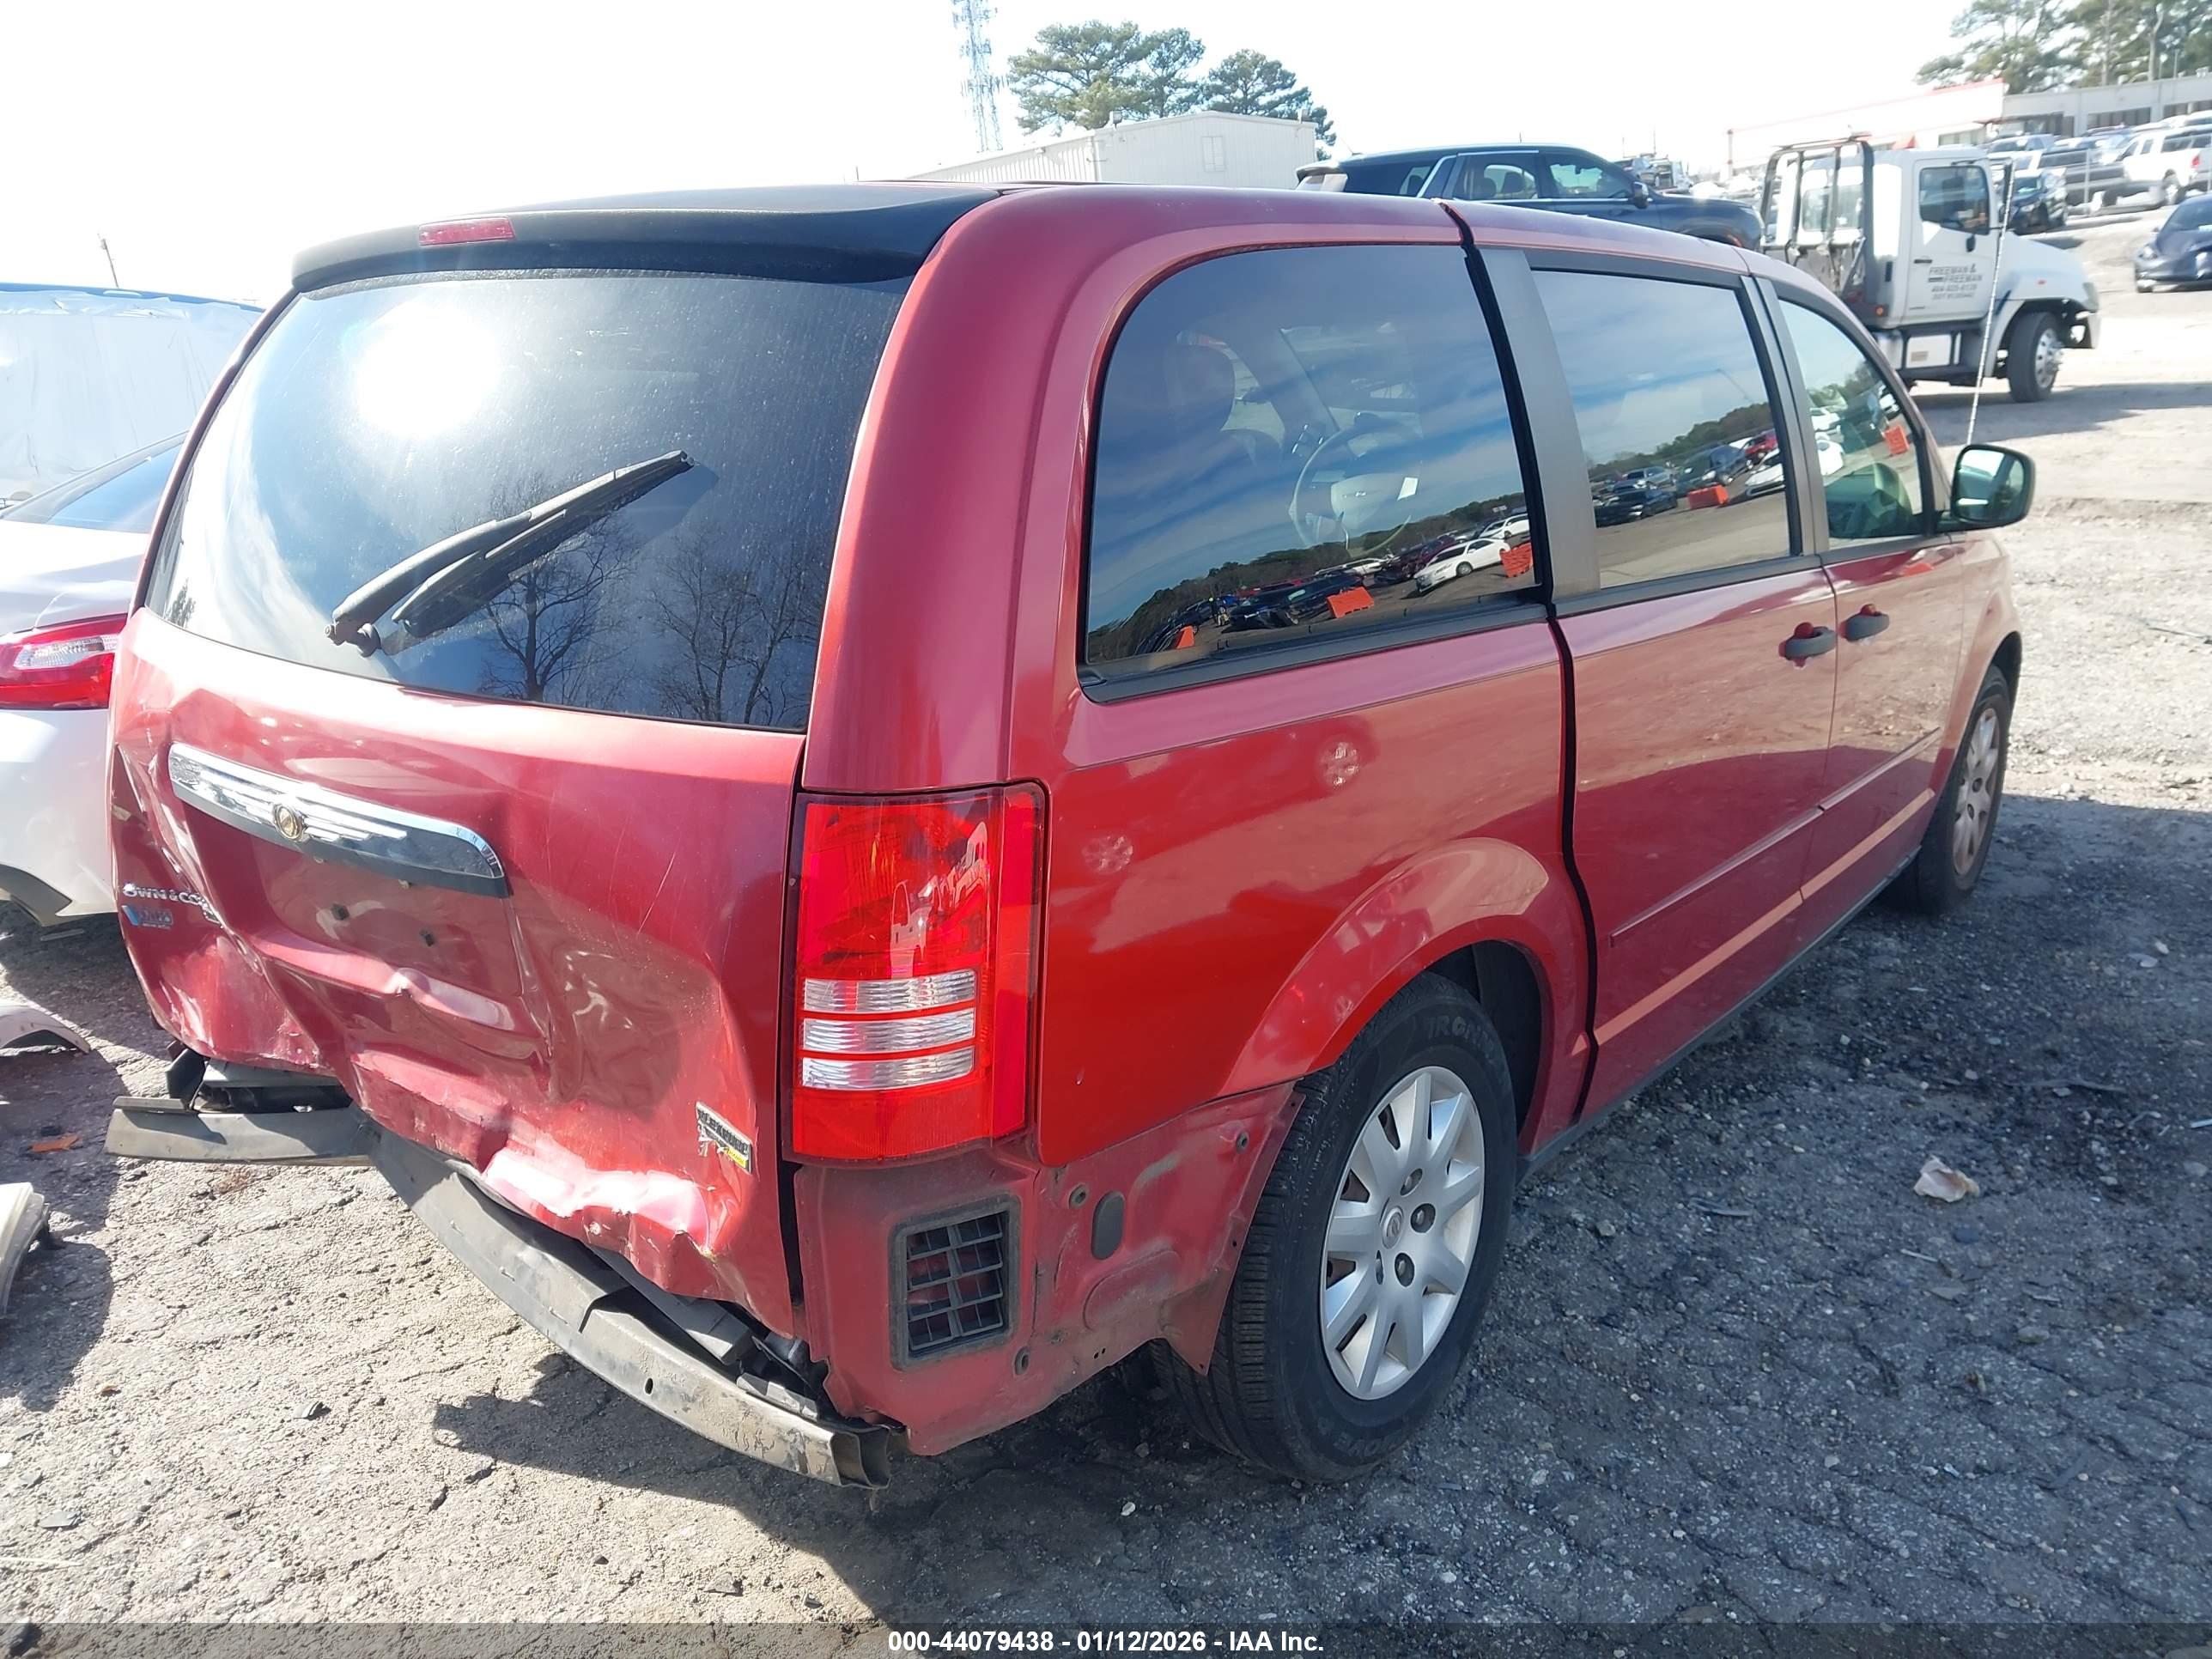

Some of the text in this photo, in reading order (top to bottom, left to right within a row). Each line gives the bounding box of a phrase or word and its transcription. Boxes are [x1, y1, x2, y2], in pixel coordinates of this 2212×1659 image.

[1929, 263, 1977, 275] FREEMAN &
[1944, 274, 1982, 283] FREEMAN
